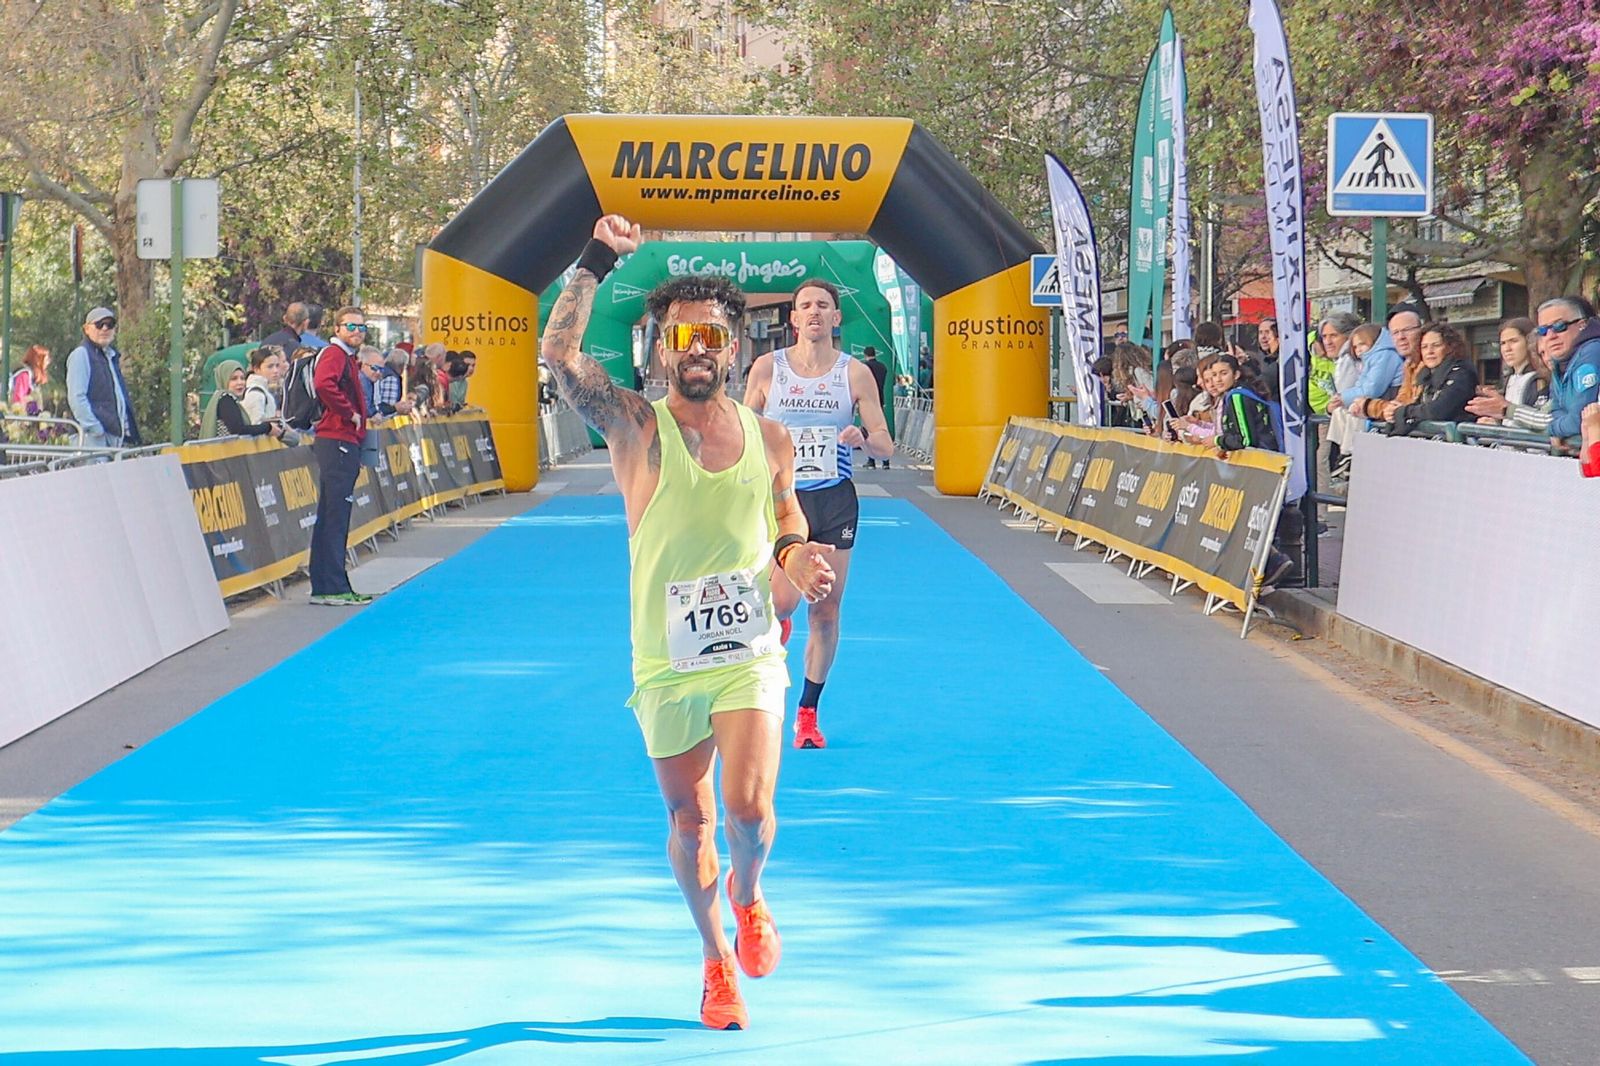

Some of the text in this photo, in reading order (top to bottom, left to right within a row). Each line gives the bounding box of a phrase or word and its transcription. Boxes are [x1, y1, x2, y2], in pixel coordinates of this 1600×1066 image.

[611, 141, 871, 181] MARCELINO
[641, 184, 840, 203] www.mpmarcelino.es
[667, 251, 806, 283] El Corte Inglés
[431, 311, 528, 337] agustinos
[948, 314, 1044, 341] agustinos
[443, 337, 516, 346] GRANADA
[961, 340, 1034, 350] GRANADA
[779, 398, 840, 410] MARACENA
[684, 602, 749, 632] 1769
[698, 628, 742, 640] JORDAN NOEL
